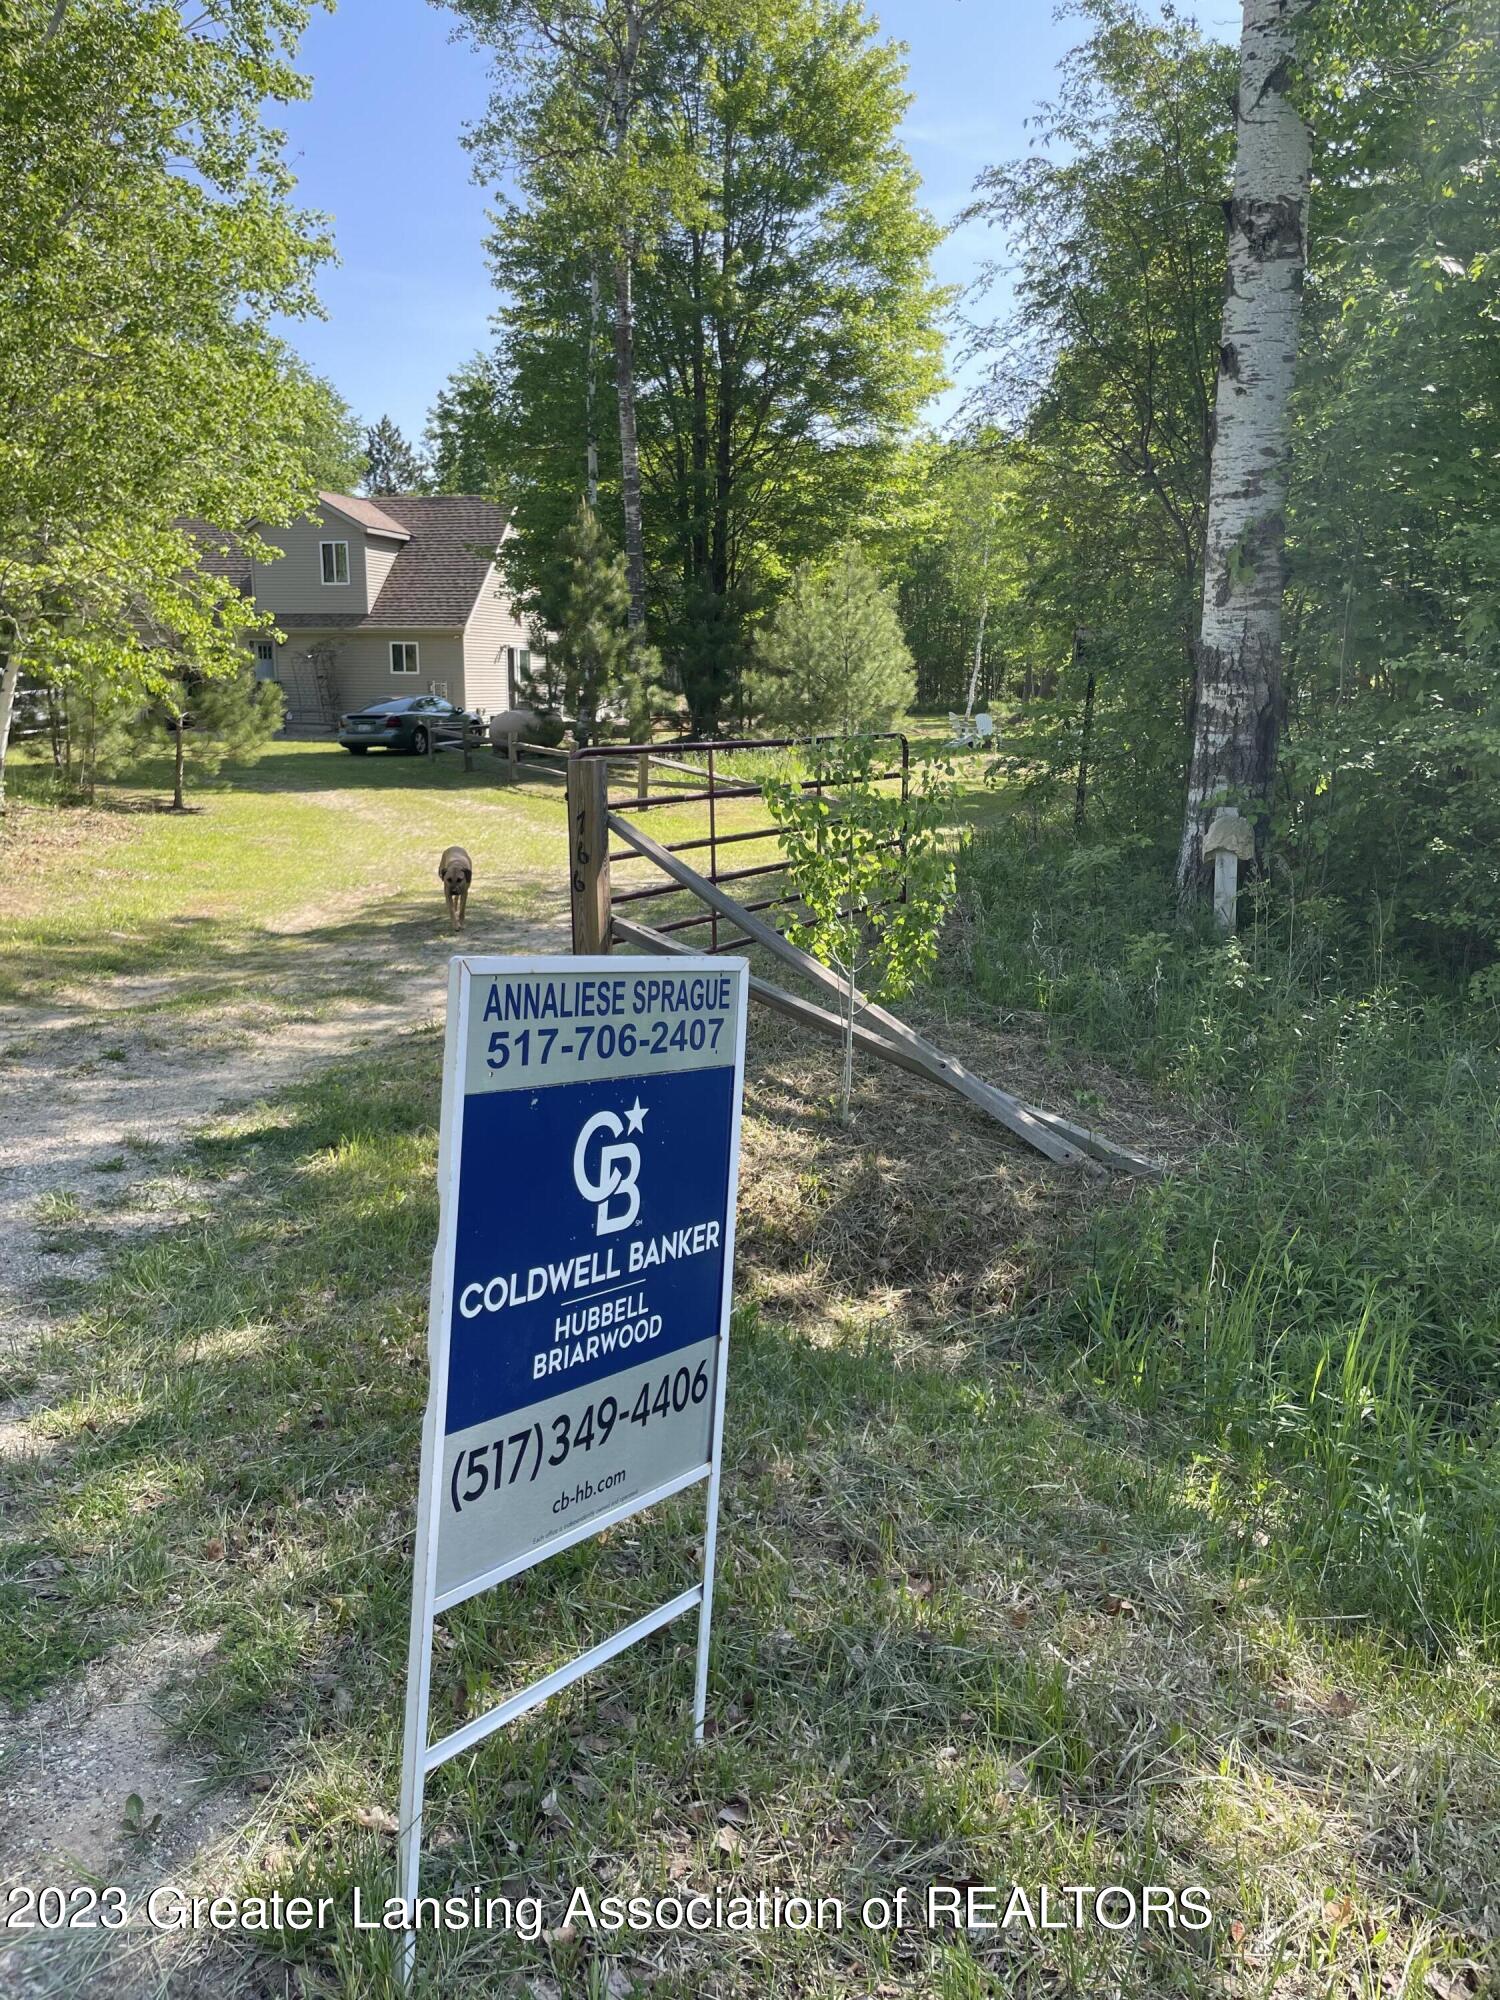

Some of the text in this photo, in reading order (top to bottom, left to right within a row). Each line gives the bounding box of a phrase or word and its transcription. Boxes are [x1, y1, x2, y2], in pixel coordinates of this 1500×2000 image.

[483, 978, 731, 1022] ANNALIESE SPRAGUE
[486, 1018, 725, 1069] 517-706-2407
[459, 1220, 720, 1319] COLDWELL BANKER
[555, 1292, 649, 1343] HUBBELL
[533, 1314, 663, 1380] BRIARWOOD
[552, 1467, 626, 1514] cb-hb.com
